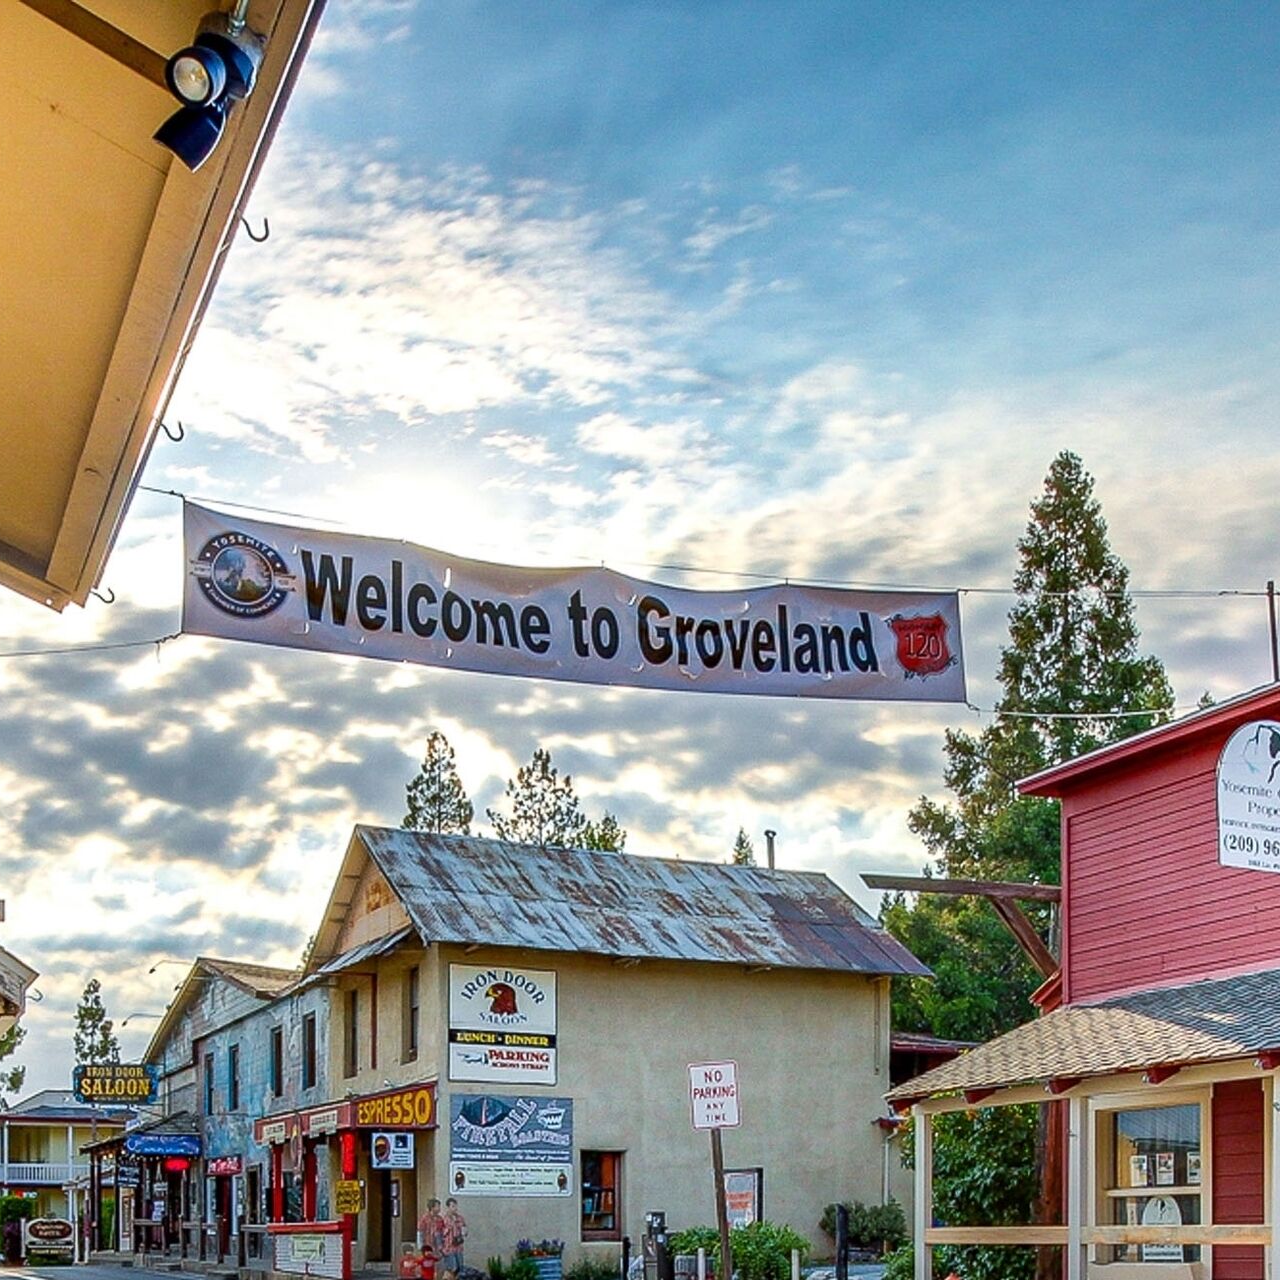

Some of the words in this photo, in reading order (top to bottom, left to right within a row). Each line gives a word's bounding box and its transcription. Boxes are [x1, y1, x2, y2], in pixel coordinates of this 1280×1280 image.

[212, 535, 275, 557] YOSEMITE
[301, 550, 551, 654] Welcome
[567, 589, 619, 659] to
[637, 595, 879, 673] Groveland
[904, 632, 943, 661] 120
[1221, 778, 1273, 799] Yosemite
[1223, 833, 1260, 858] (209)
[461, 970, 499, 1000] IRON
[503, 970, 546, 1005] DOOR
[479, 1012, 528, 1025] SALOON
[456, 1032, 496, 1043] LUNCH
[504, 1034, 550, 1046] DINNER
[488, 1049, 550, 1062] PARKING
[86, 1066, 113, 1077] IRON
[115, 1066, 144, 1077] DOOR
[704, 1071, 723, 1083] NO
[80, 1078, 151, 1096] SALOON
[693, 1085, 736, 1100] PARKING
[358, 1089, 432, 1125] ESPRESSO
[706, 1102, 725, 1110] ANY
[705, 1113, 726, 1122] TIME
